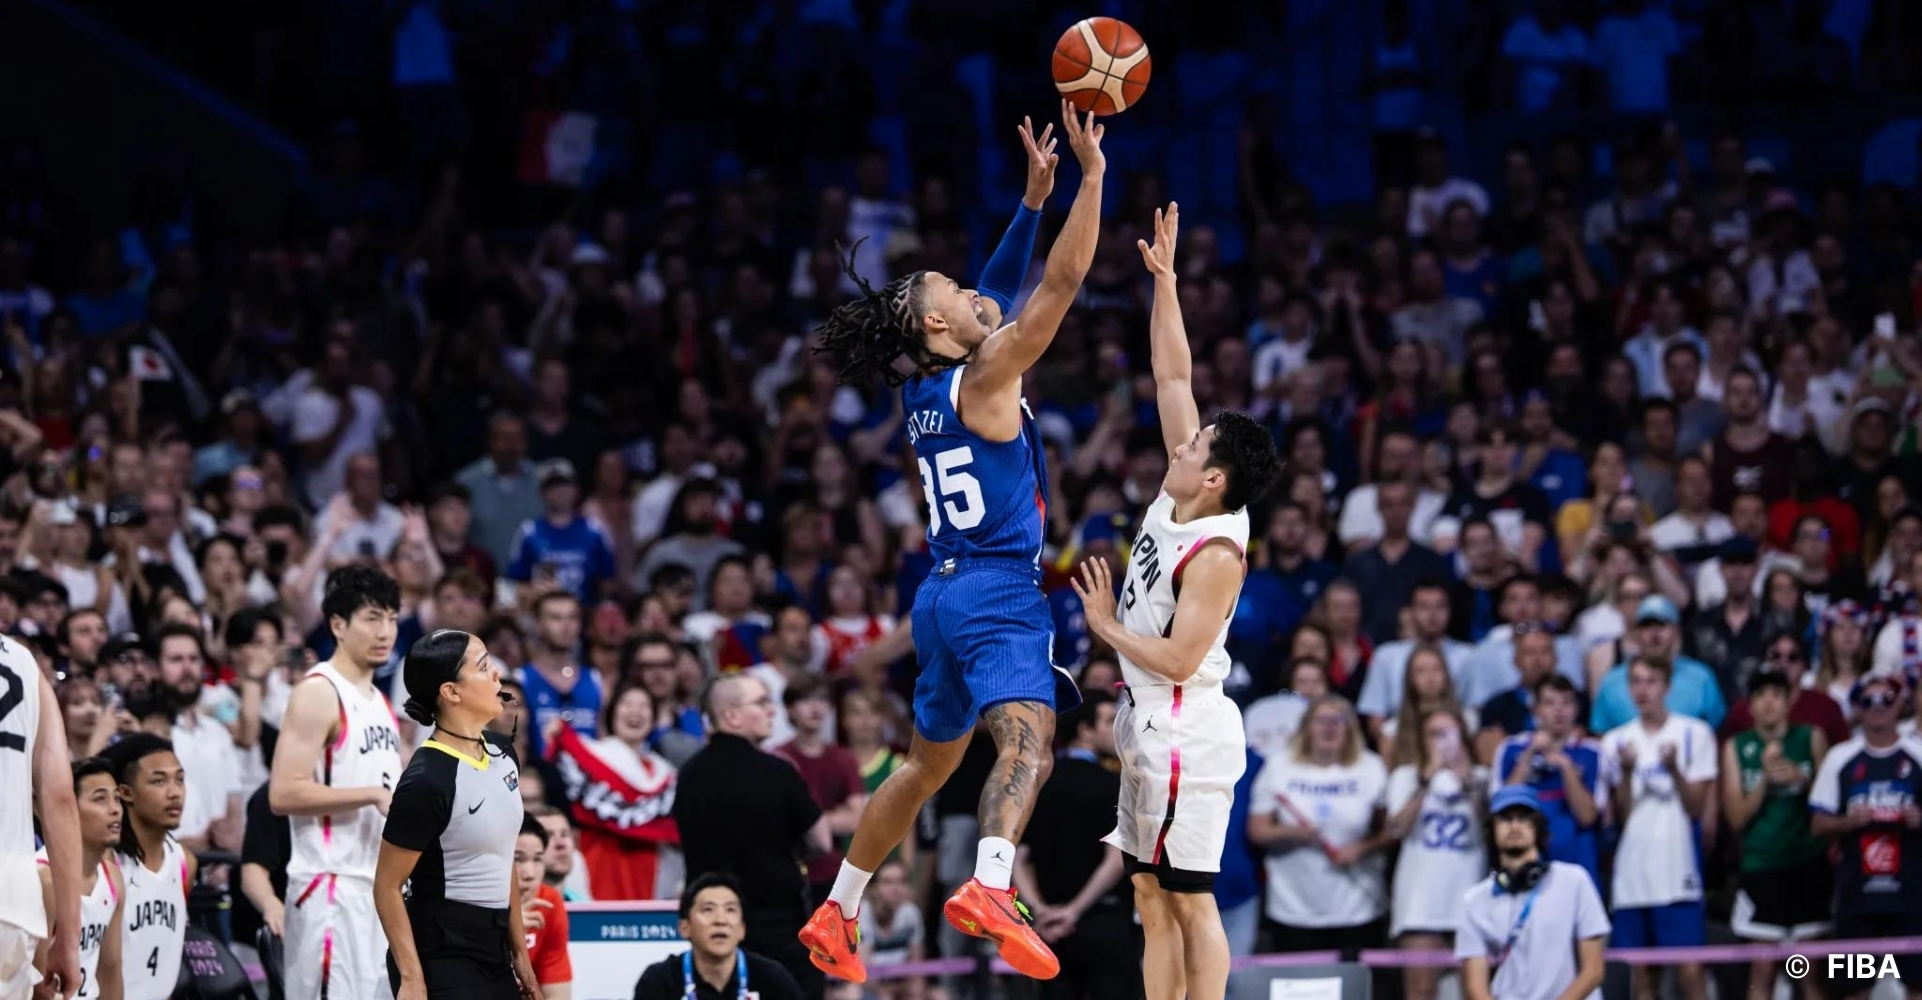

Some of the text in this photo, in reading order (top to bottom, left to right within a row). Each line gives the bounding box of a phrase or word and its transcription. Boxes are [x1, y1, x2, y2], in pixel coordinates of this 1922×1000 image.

[1423, 812, 1470, 850] 32
[130, 900, 176, 932] JAPAN
[601, 925, 677, 939] PARIS 2024
[146, 946, 159, 976] 4
